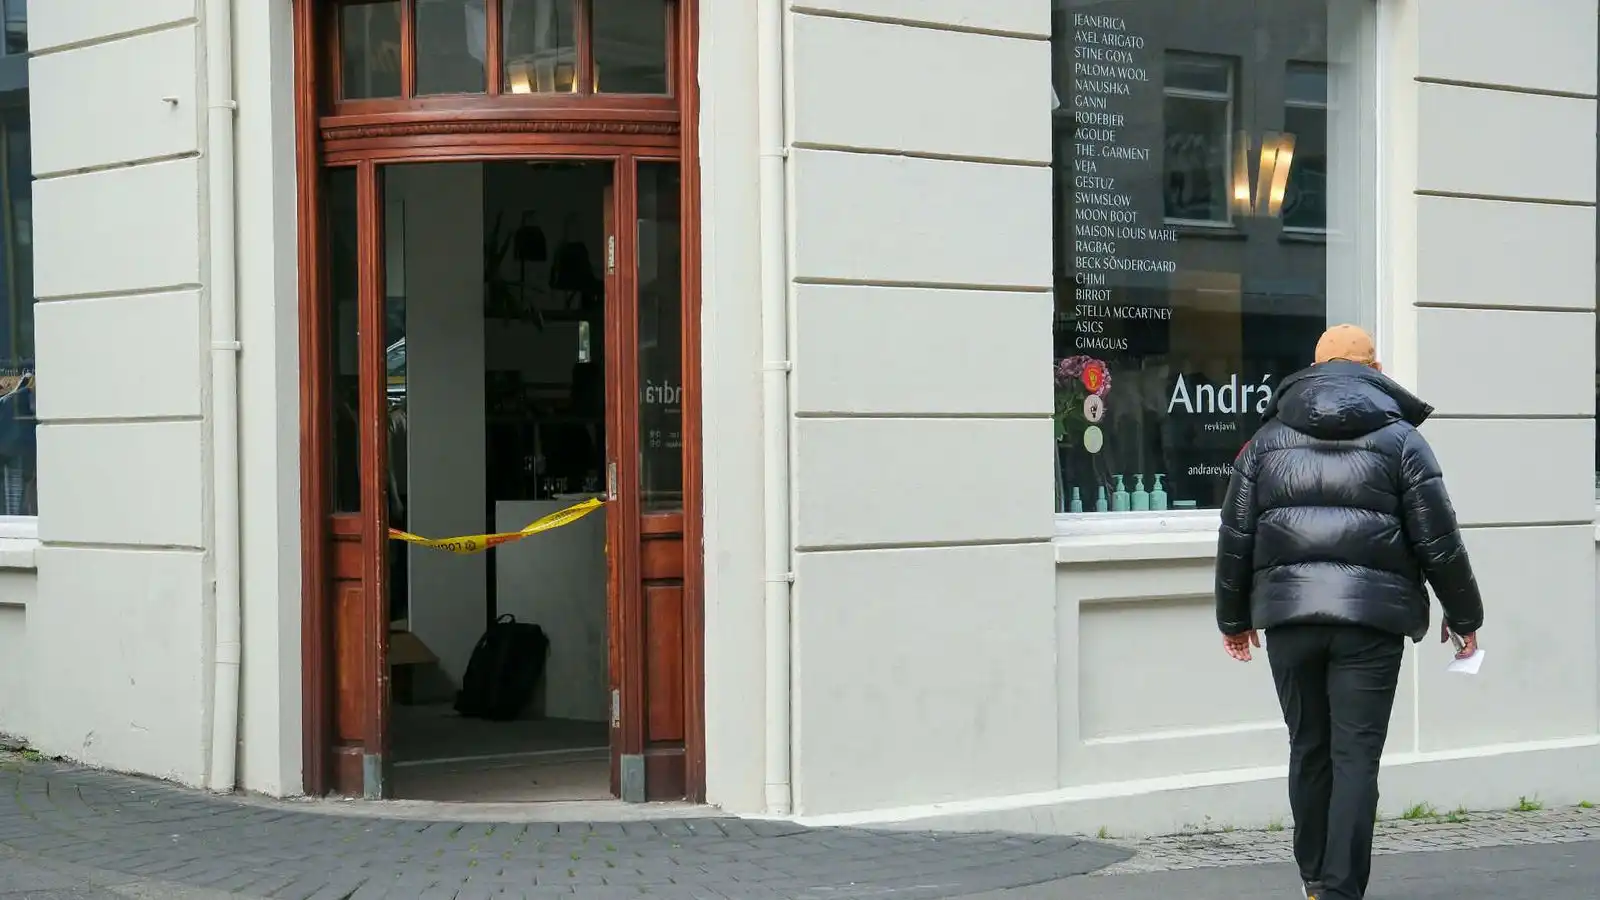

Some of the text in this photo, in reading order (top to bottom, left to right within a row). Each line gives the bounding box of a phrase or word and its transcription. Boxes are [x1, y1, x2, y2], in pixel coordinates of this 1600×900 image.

[1074, 13, 1126, 31] JEANERICA
[1074, 30, 1145, 49] AXEL ARIGATO
[1074, 46, 1134, 64] STINE GOYA
[1075, 62, 1149, 82] PALOMA WOOL
[1075, 79, 1130, 96] NANUSHKA
[1074, 95, 1107, 110] GANNI
[1075, 111, 1124, 128] RODEBJER
[1074, 127, 1116, 142] AGOLDE
[1075, 143, 1095, 157] THE
[1101, 145, 1150, 161] GARMENT
[1075, 159, 1097, 174] VEJA
[1075, 175, 1115, 190] GESTUZ
[1075, 191, 1132, 207] SWIMSLOW
[1075, 208, 1137, 224] MOON BOOT
[1075, 224, 1178, 242] MAISON LOUIS MARIE
[1075, 240, 1116, 254] RAGBAG
[1075, 256, 1101, 269] BECK
[1075, 272, 1106, 286] CHIMI
[1075, 288, 1112, 301] BIRROT
[1075, 304, 1173, 320] STELLA MCCARTNEY
[1075, 320, 1104, 334] ASICS
[1075, 336, 1128, 350] GIMAGUAS
[1167, 372, 1273, 414] Andrá
